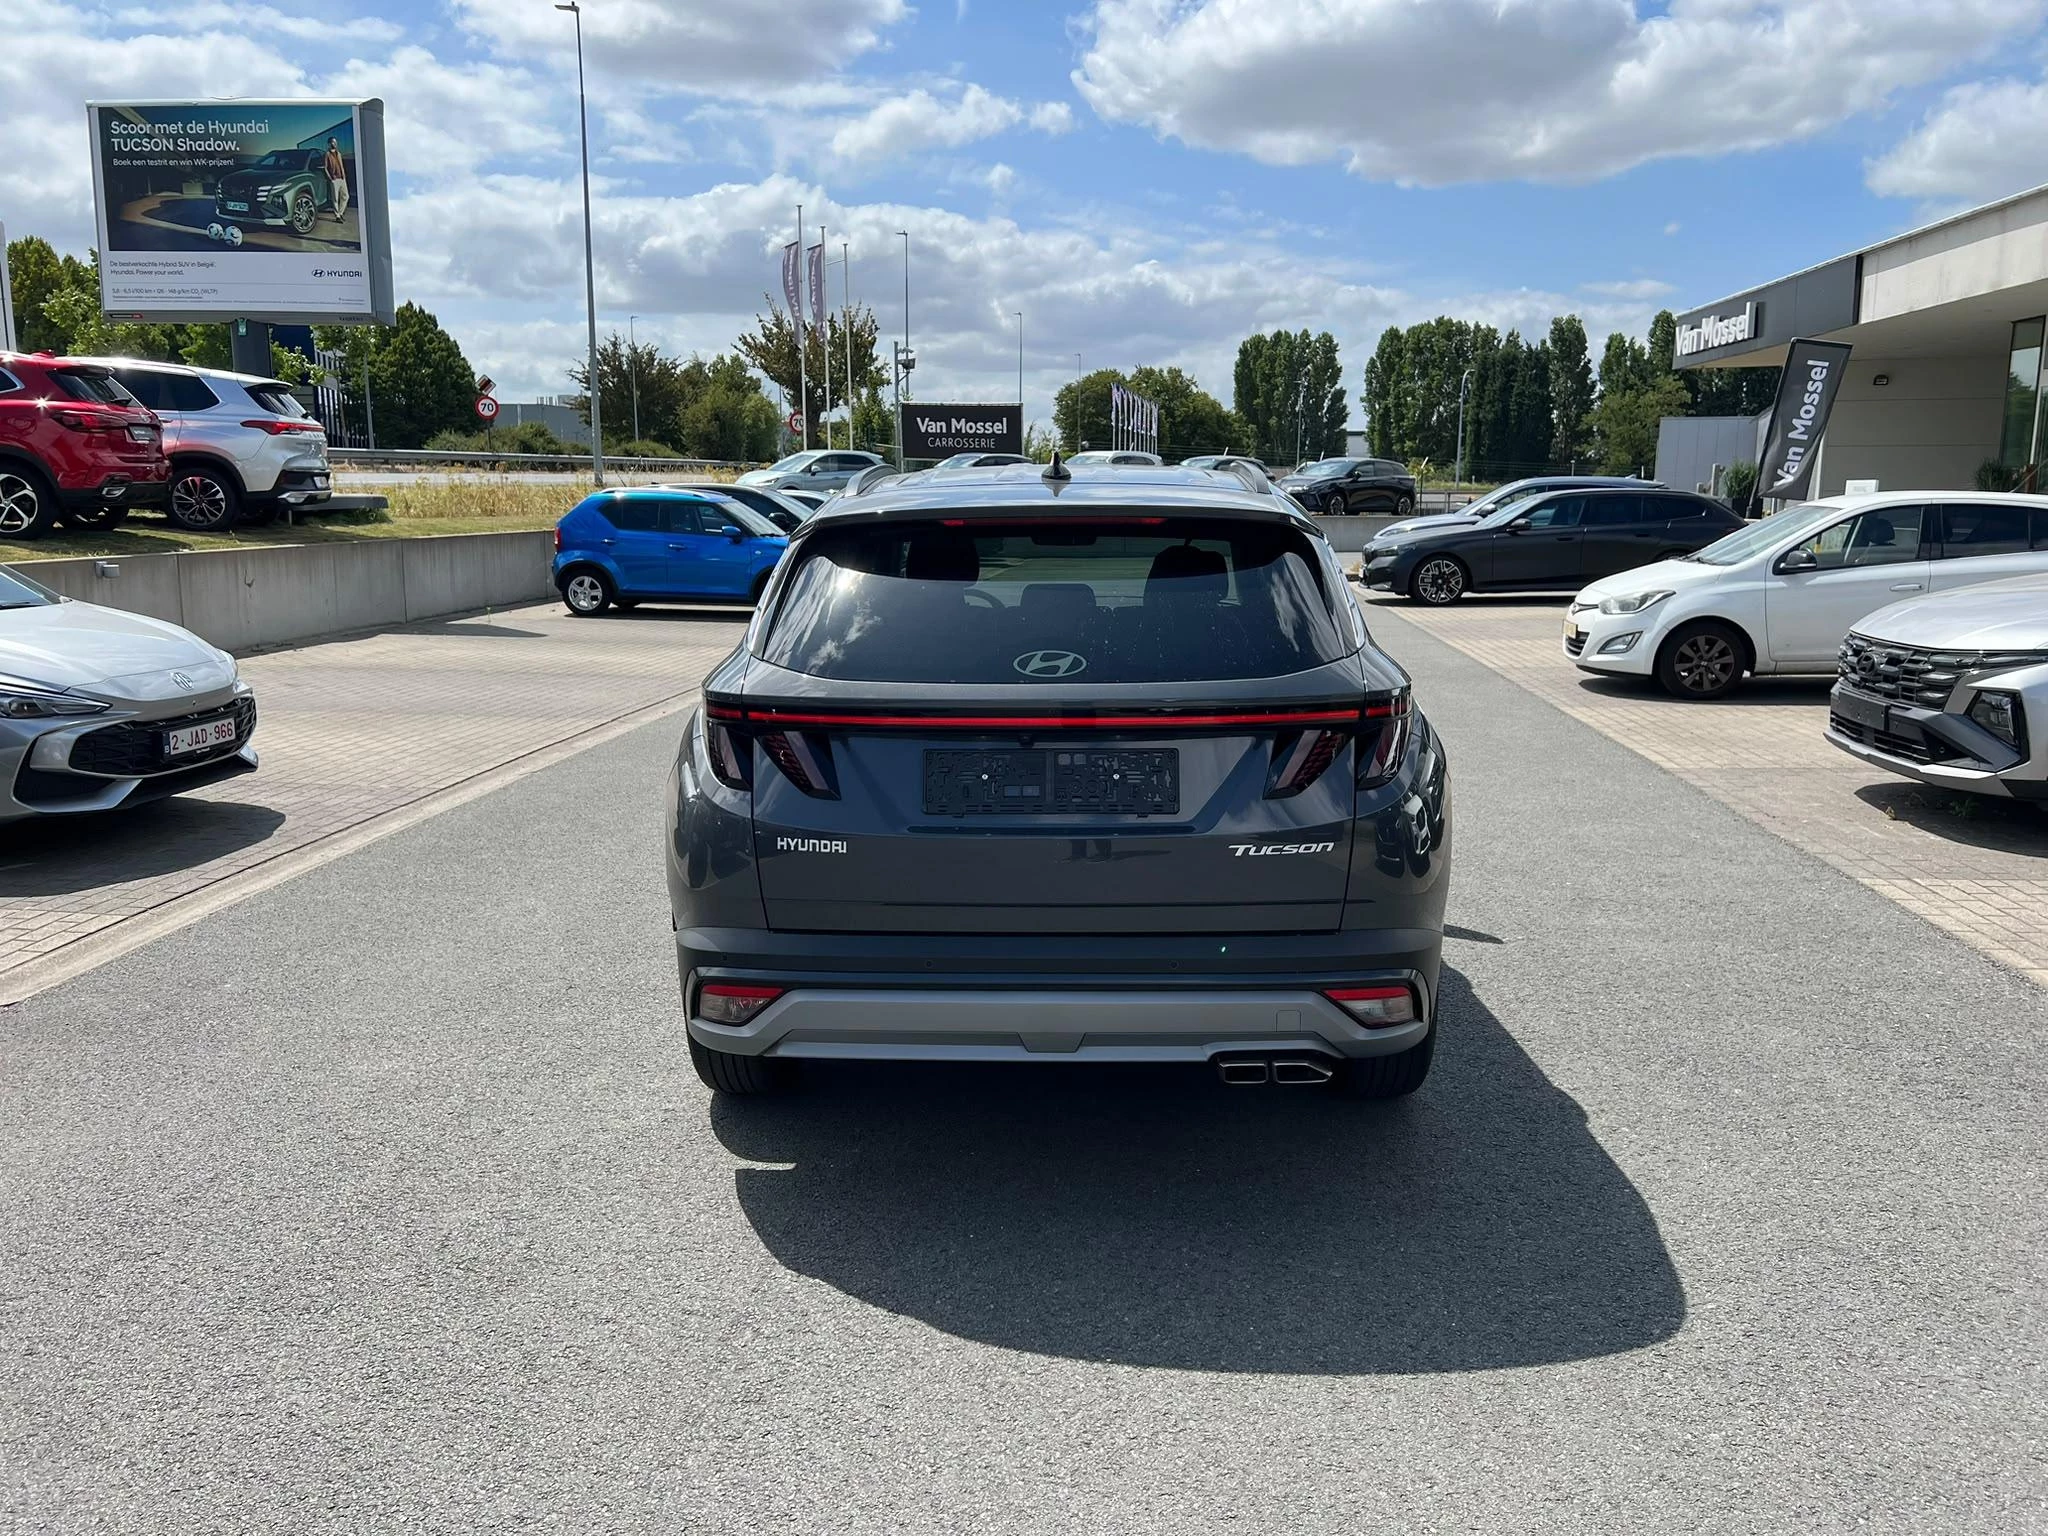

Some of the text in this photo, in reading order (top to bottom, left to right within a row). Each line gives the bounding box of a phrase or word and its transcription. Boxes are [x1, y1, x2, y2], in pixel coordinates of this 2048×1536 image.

[111, 119, 269, 137] Scoor met de Hyundai
[111, 138, 240, 151] TUCSON Shadow.
[113, 158, 132, 166] Boek
[180, 158, 192, 166] win
[194, 158, 234, 168] WK-prijzen!
[327, 270, 362, 278] HYUNDAI
[1675, 301, 1756, 357] Van Mossel
[480, 403, 494, 412] 70
[916, 416, 1007, 435] Van Mossel
[1773, 359, 1830, 487] Van Mossel
[927, 437, 996, 449] CARROSSERIE
[776, 837, 848, 854] HYUNDAI
